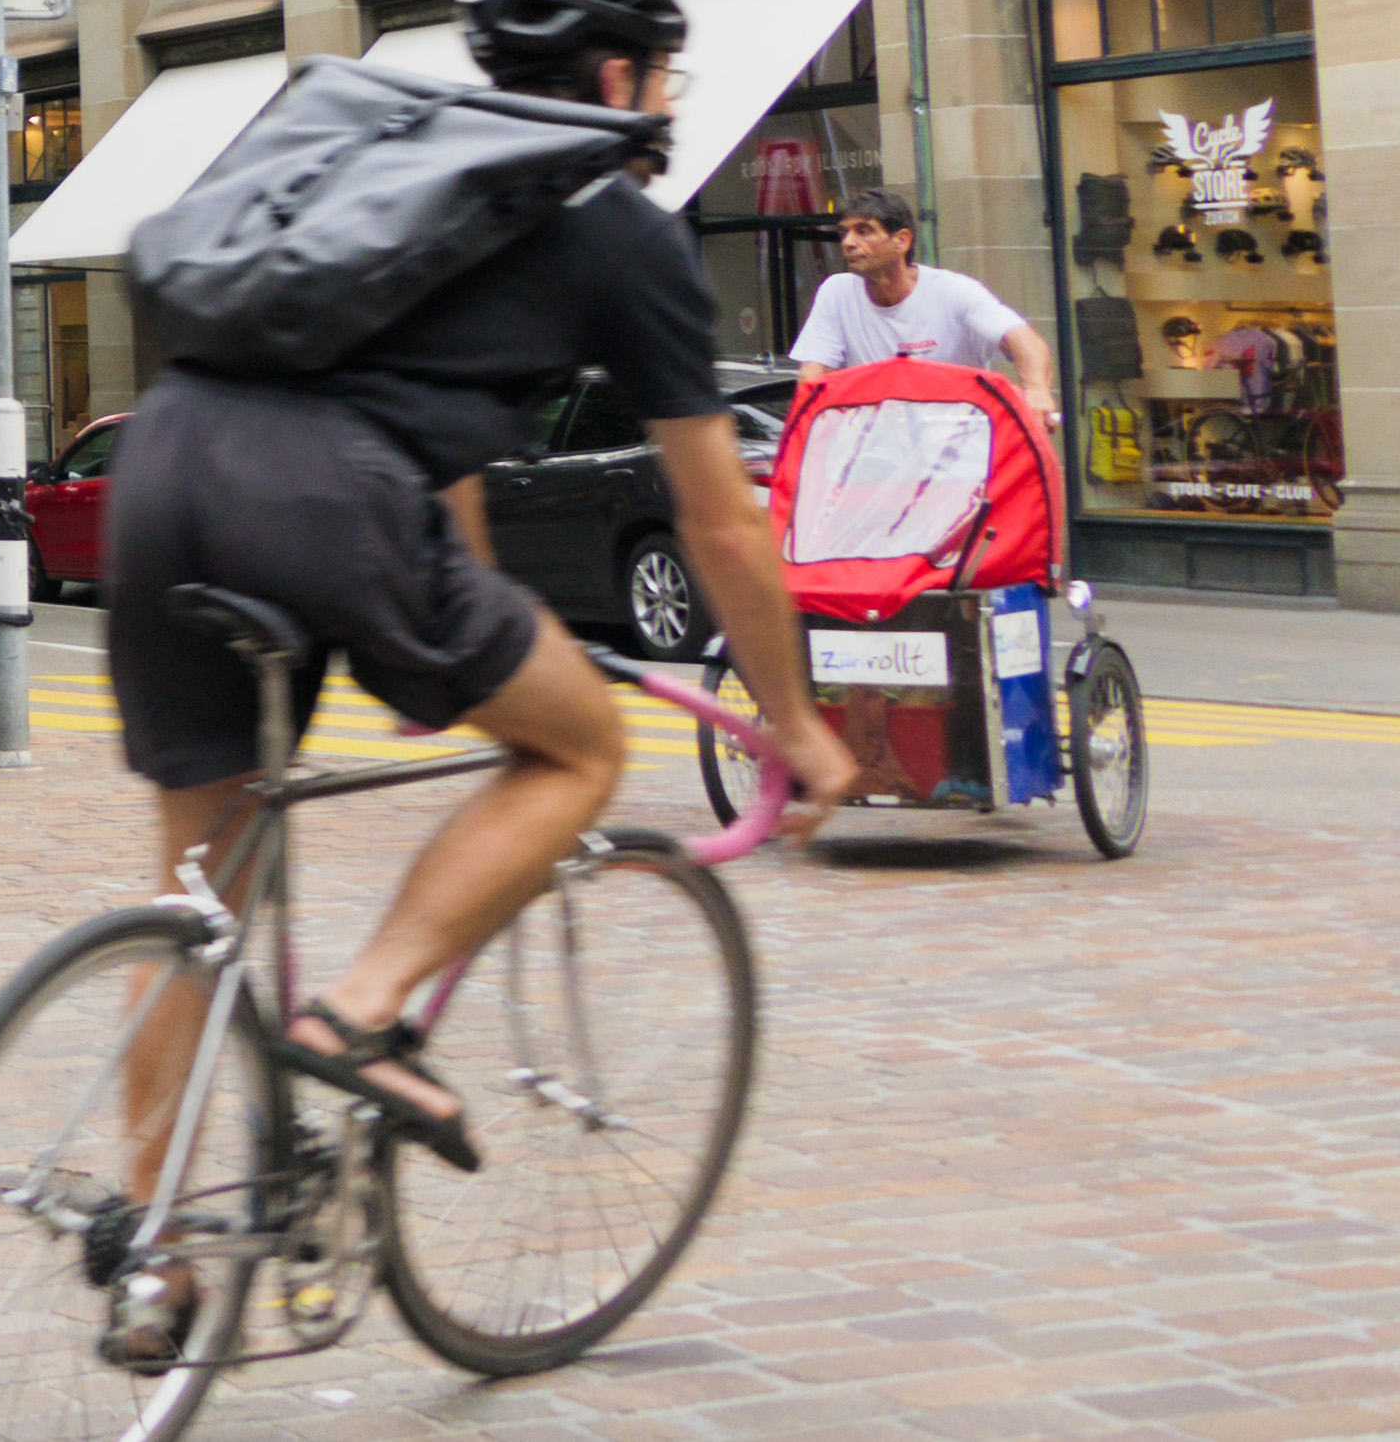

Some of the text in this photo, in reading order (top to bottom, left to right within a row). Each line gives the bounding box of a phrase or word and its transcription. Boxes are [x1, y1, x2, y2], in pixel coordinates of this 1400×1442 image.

[1193, 113, 1243, 158] Cycle
[1192, 168, 1249, 202] STORE
[1170, 482, 1213, 497] STORE
[1276, 485, 1313, 500] CLUB
